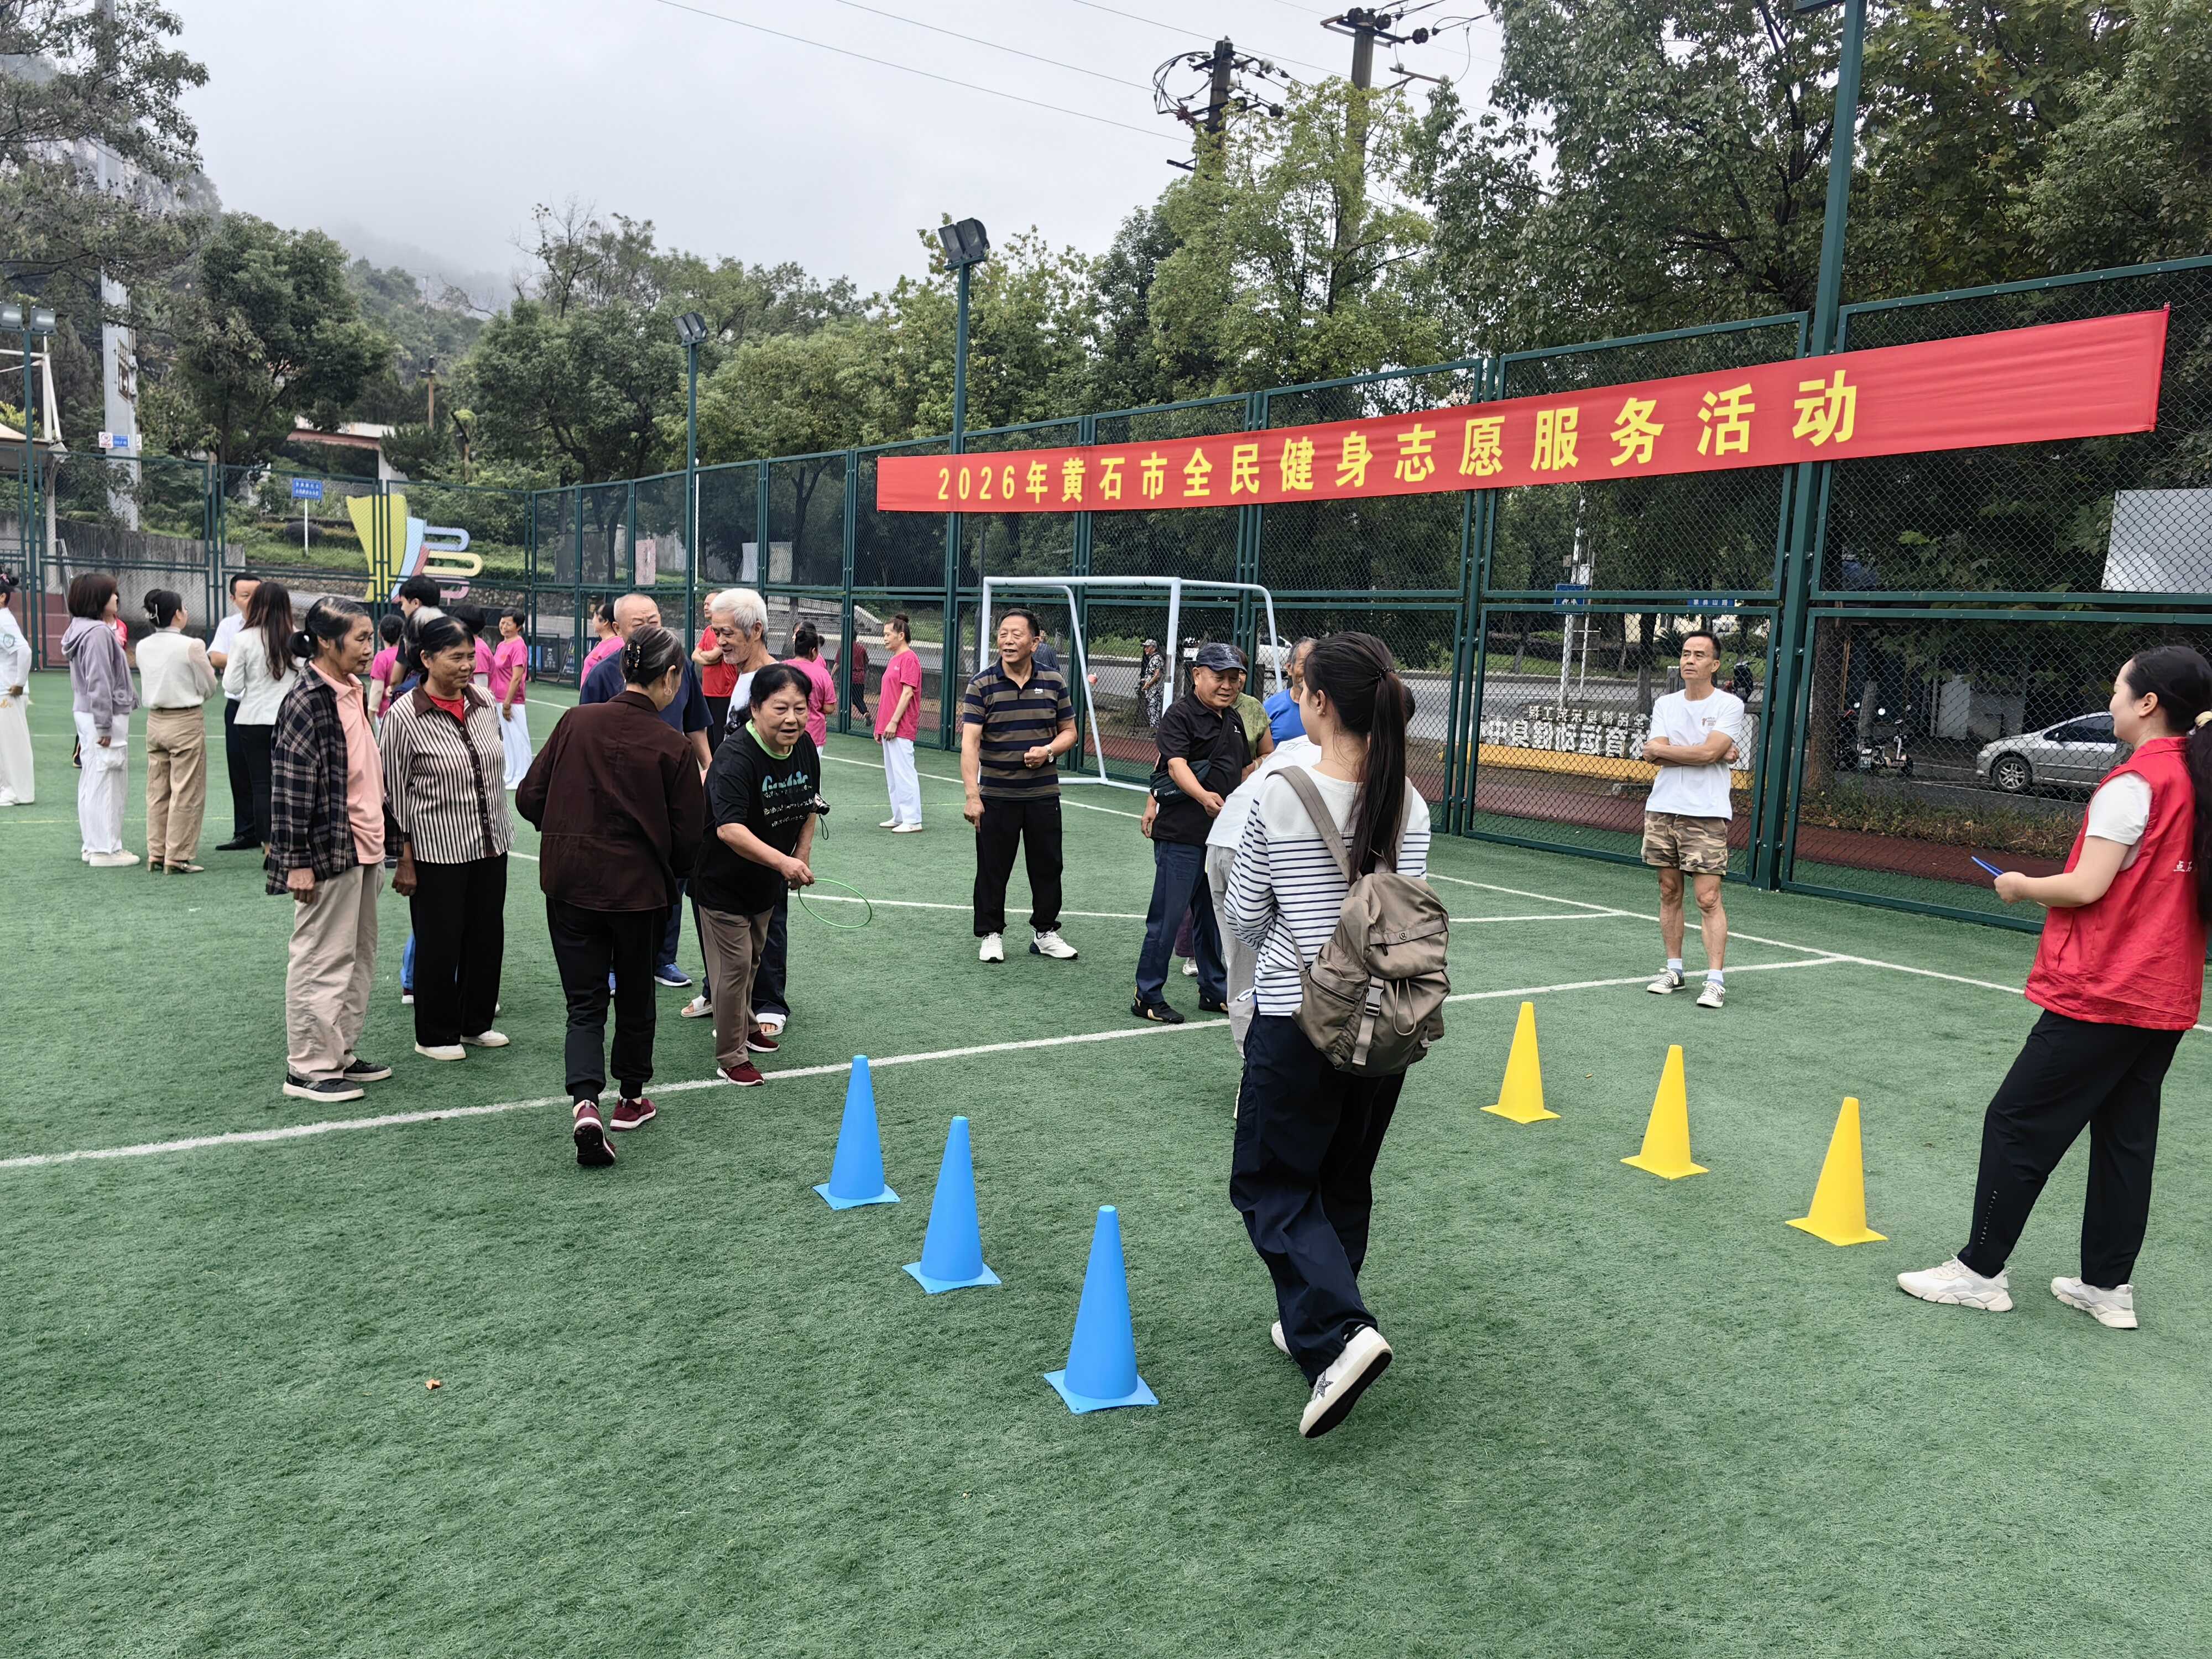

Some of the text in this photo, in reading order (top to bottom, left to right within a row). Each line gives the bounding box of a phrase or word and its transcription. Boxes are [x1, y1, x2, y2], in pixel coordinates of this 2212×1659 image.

[938, 370, 1857, 503] 2026年黄石市全民健身志愿服务活动
